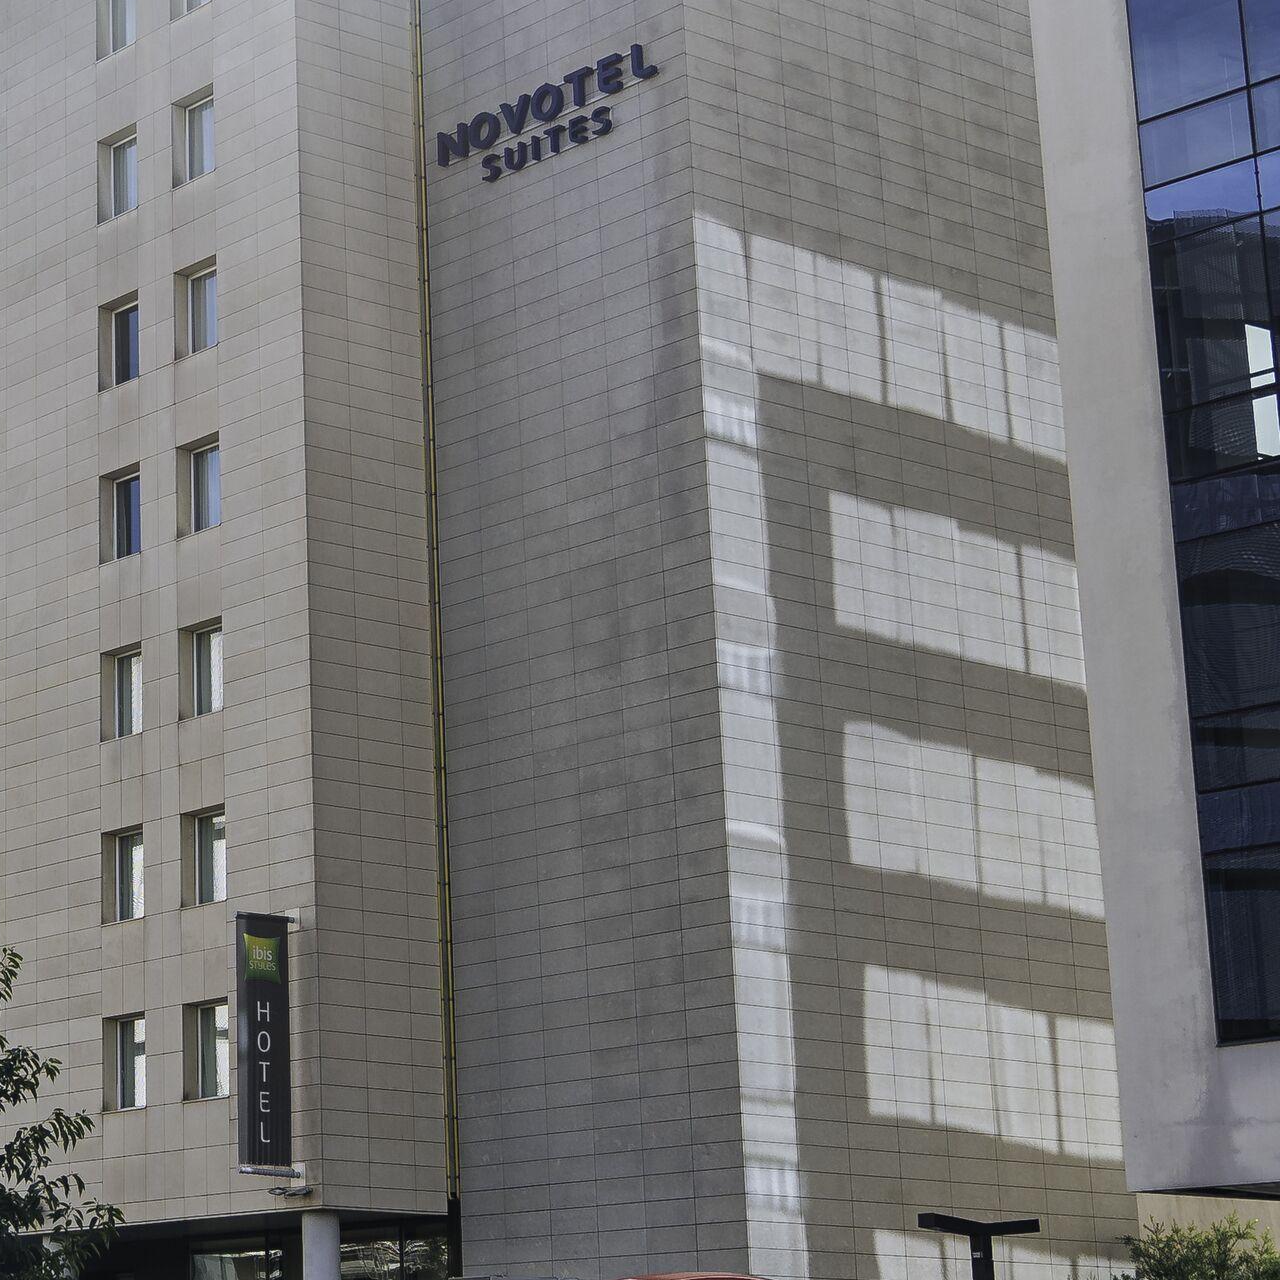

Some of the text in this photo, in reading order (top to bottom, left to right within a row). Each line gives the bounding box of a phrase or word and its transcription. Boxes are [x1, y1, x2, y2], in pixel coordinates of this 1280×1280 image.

[437, 43, 658, 168] NOVOTEL
[481, 106, 613, 183] SUITES
[252, 945, 273, 962] ibis
[256, 1000, 271, 1143] HOTEL
